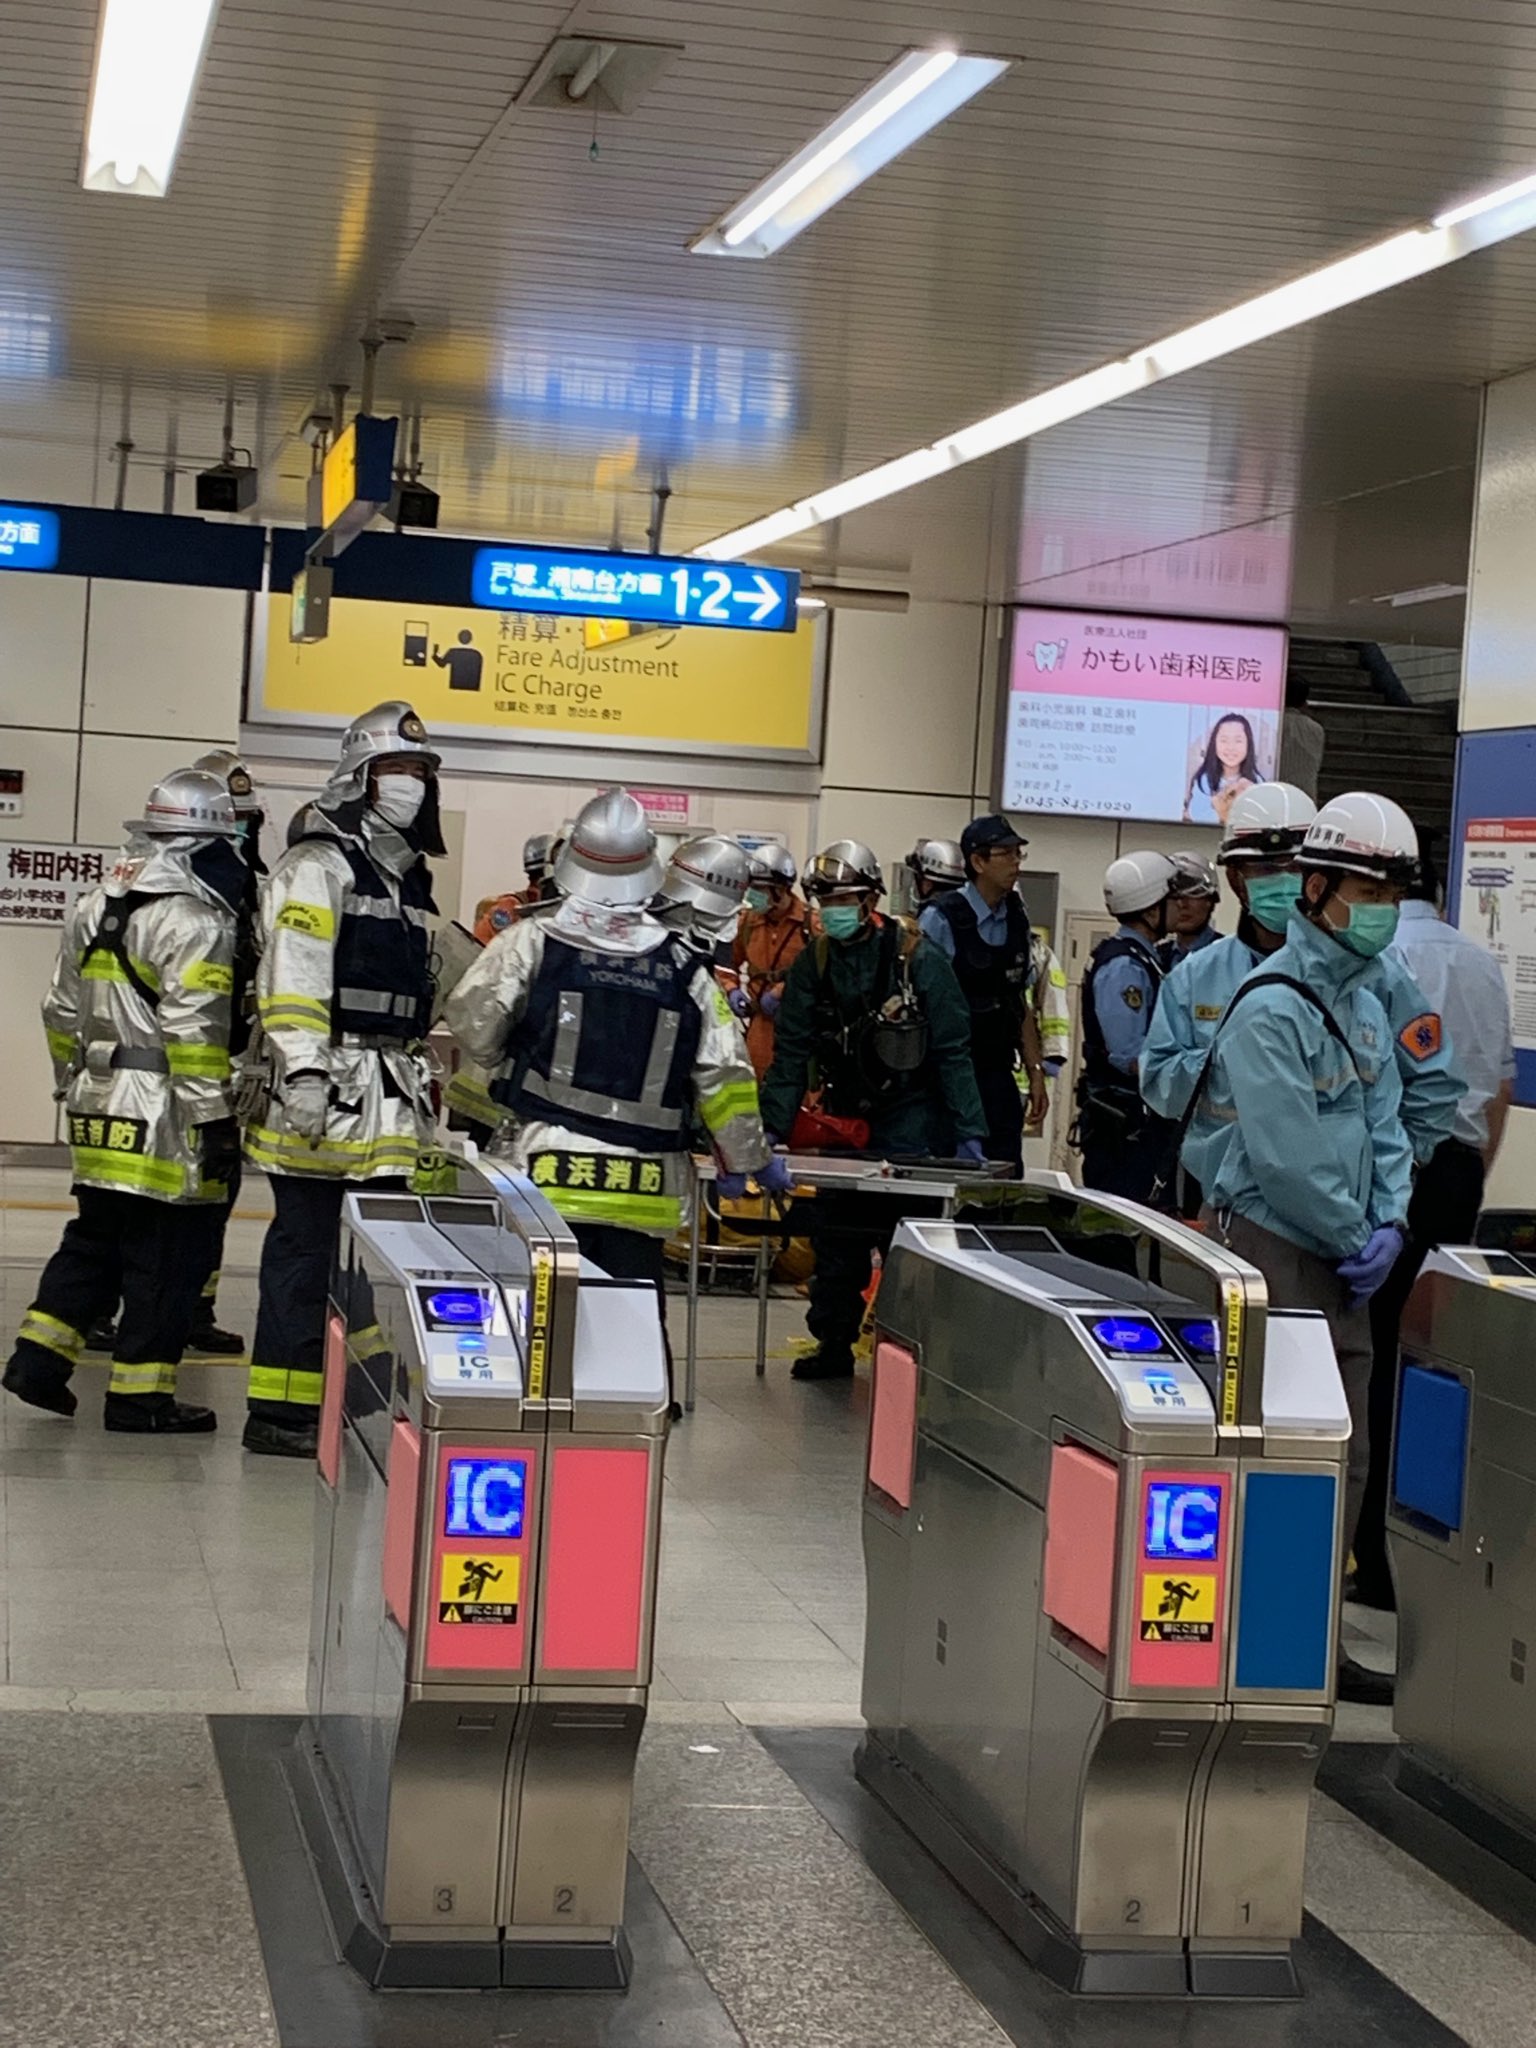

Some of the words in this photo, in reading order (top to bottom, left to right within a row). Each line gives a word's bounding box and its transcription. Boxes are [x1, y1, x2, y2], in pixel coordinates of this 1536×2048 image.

[497, 646, 543, 668] Fare
[549, 650, 679, 678] Adjustment
[1081, 647, 1262, 684] かもい歯科医院
[495, 673, 516, 693] IC
[523, 674, 602, 703] Charge
[531, 1154, 662, 1193] 横浜消防
[459, 1355, 489, 1368] IC
[1150, 1383, 1179, 1395] IC
[449, 1466, 522, 1531] IC
[1149, 1490, 1217, 1552] IC
[436, 1889, 453, 1912] 3
[557, 1889, 573, 1912] 2
[1125, 1900, 1141, 1923] 2
[1242, 1902, 1251, 1924] 1
